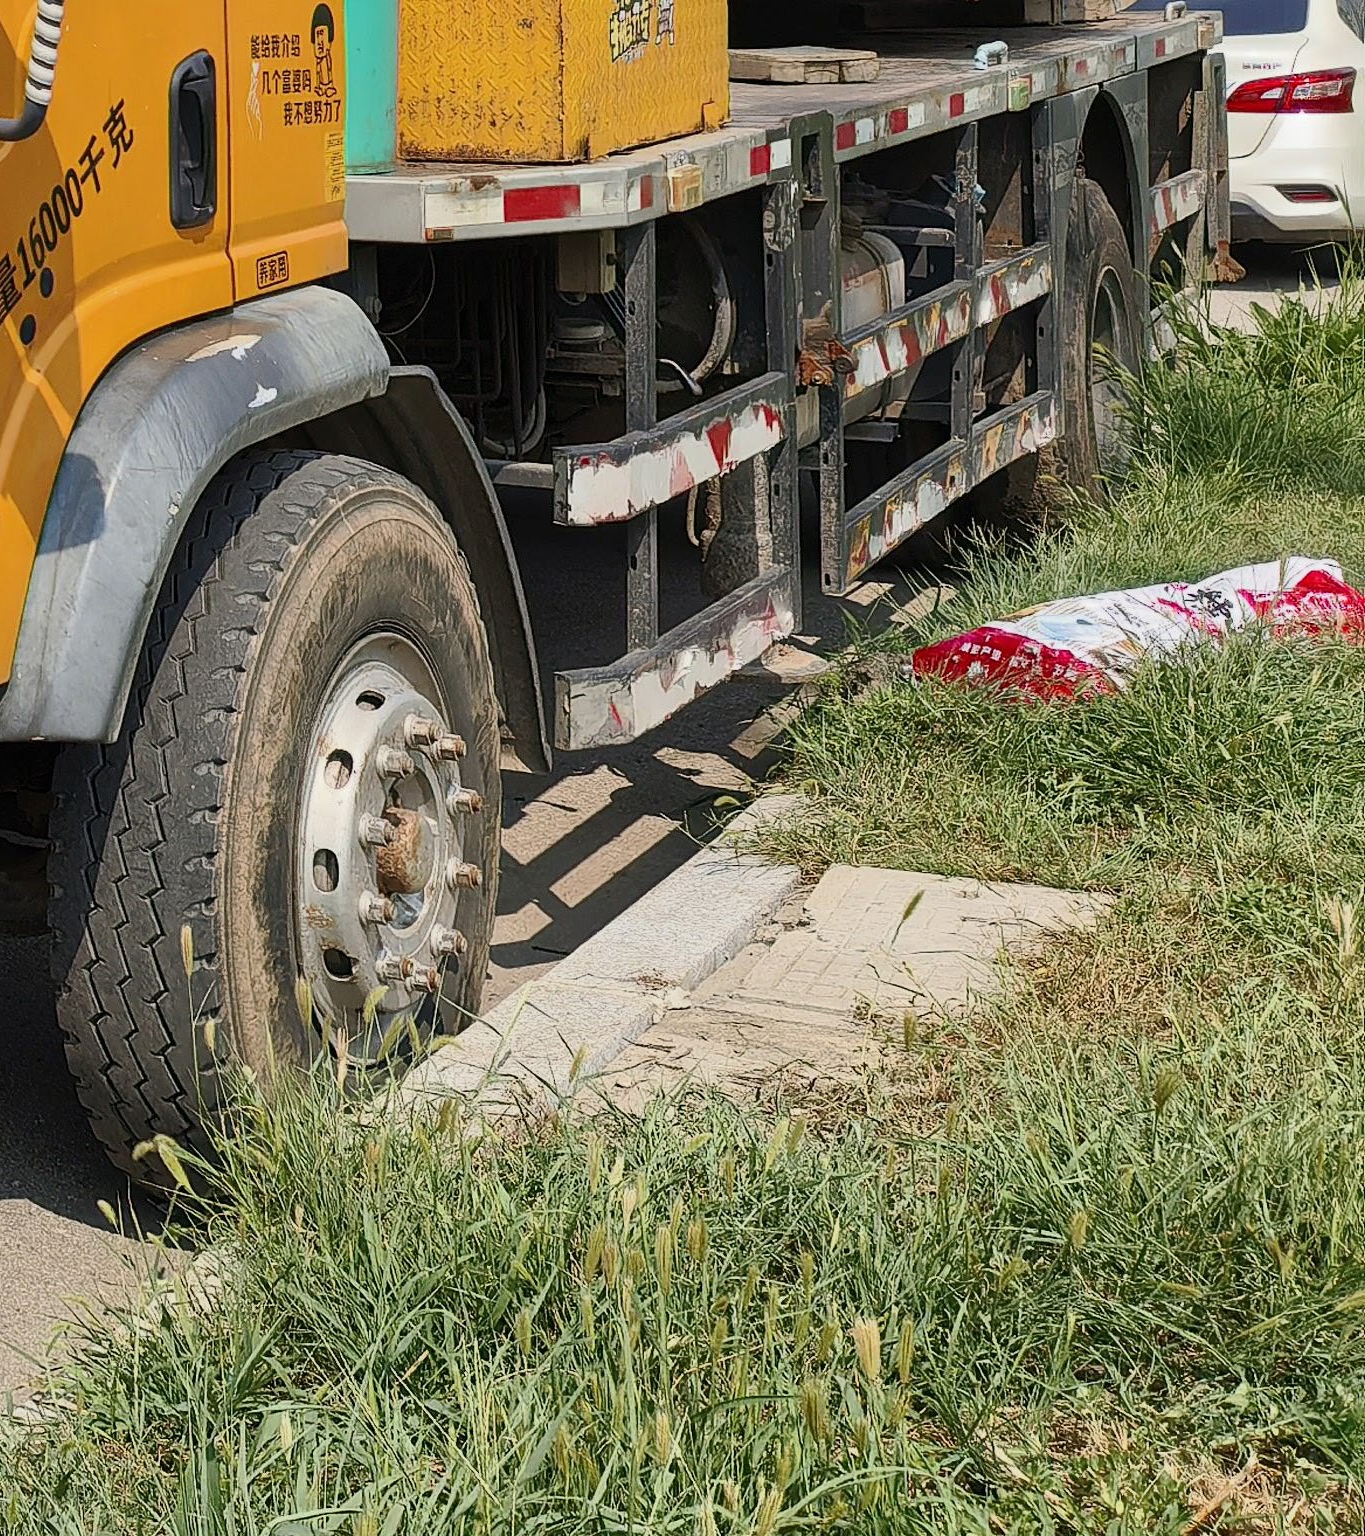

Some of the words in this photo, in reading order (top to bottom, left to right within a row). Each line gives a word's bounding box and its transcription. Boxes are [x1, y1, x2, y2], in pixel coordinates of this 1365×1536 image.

[284, 99, 341, 126] 我不想努力了
